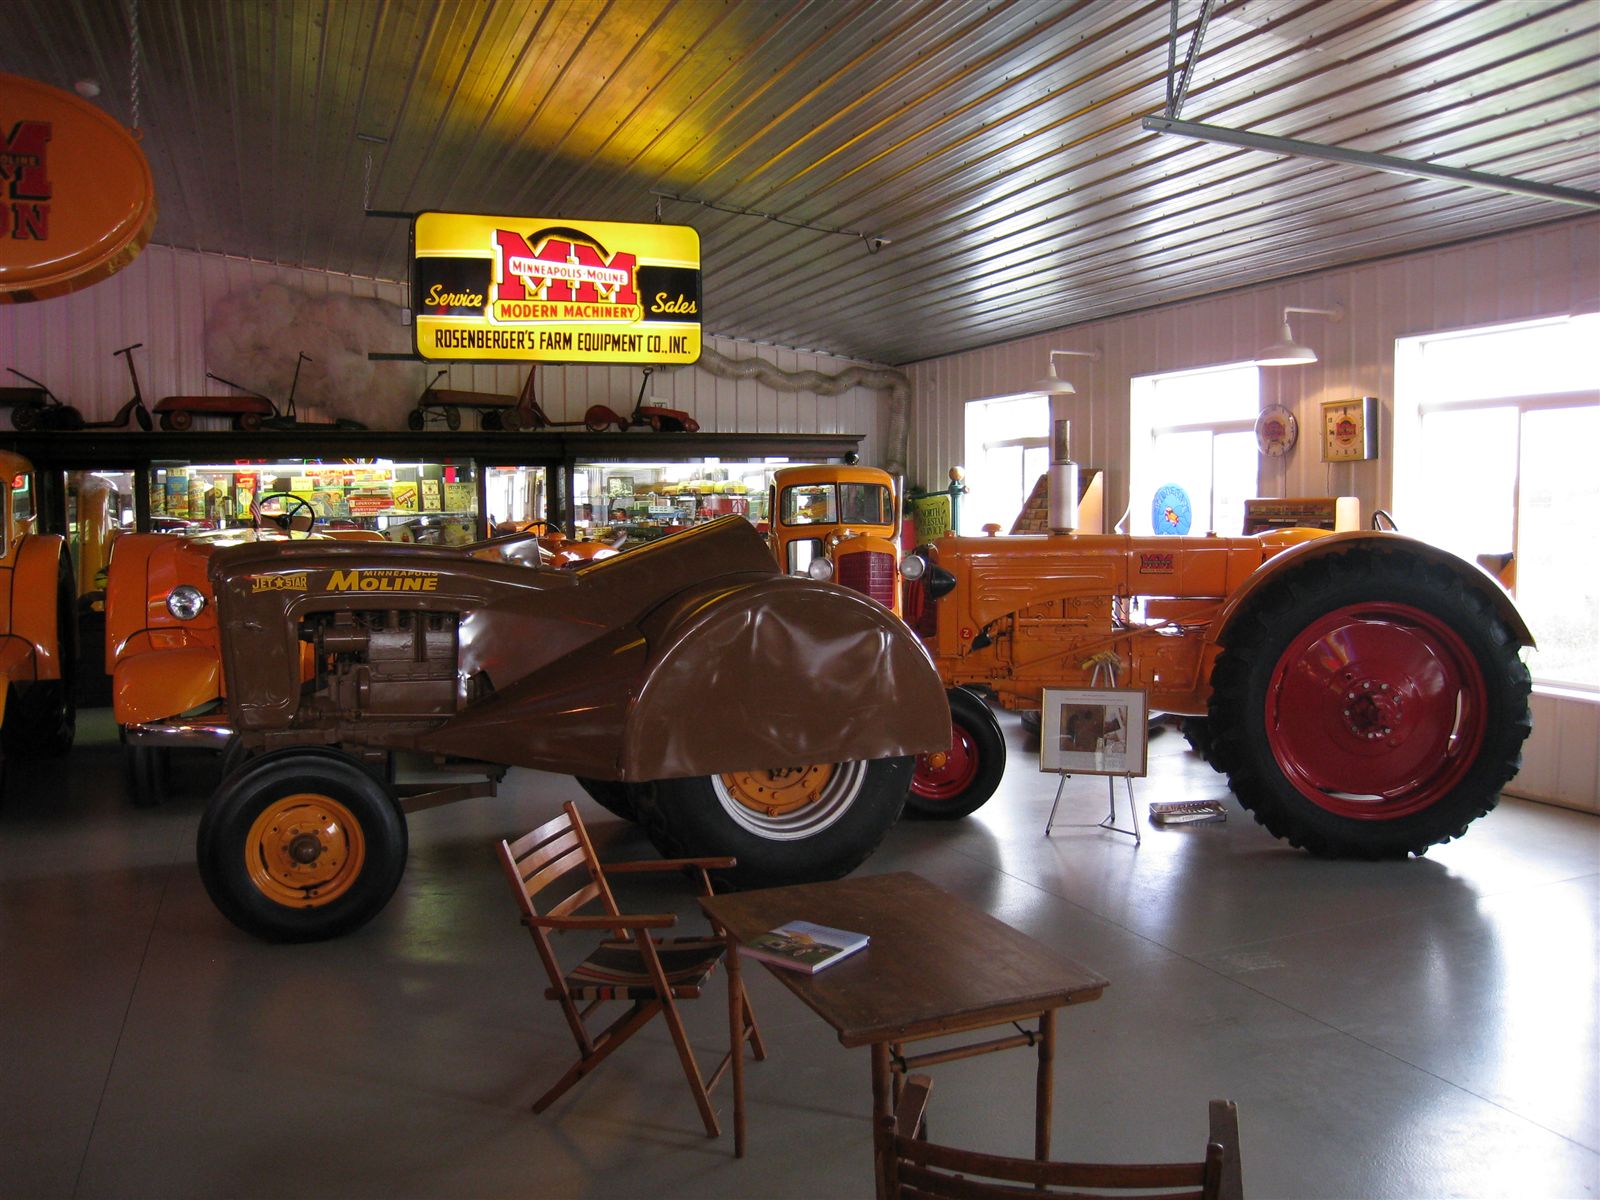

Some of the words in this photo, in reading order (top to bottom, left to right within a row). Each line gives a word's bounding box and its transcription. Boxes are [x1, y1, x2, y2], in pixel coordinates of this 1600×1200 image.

[425, 284, 483, 307] Service
[651, 292, 698, 314] Sales
[500, 303, 558, 318] MODERN
[564, 304, 635, 319] MACHINERY
[435, 328, 535, 350] ROSENBERGER'S
[539, 331, 573, 351] FARM
[577, 333, 643, 353] EQUIPMENT
[252, 577, 272, 590] JET
[286, 575, 307, 589] STAR
[326, 570, 438, 592] MOLINE
[963, 629, 969, 638] 2
